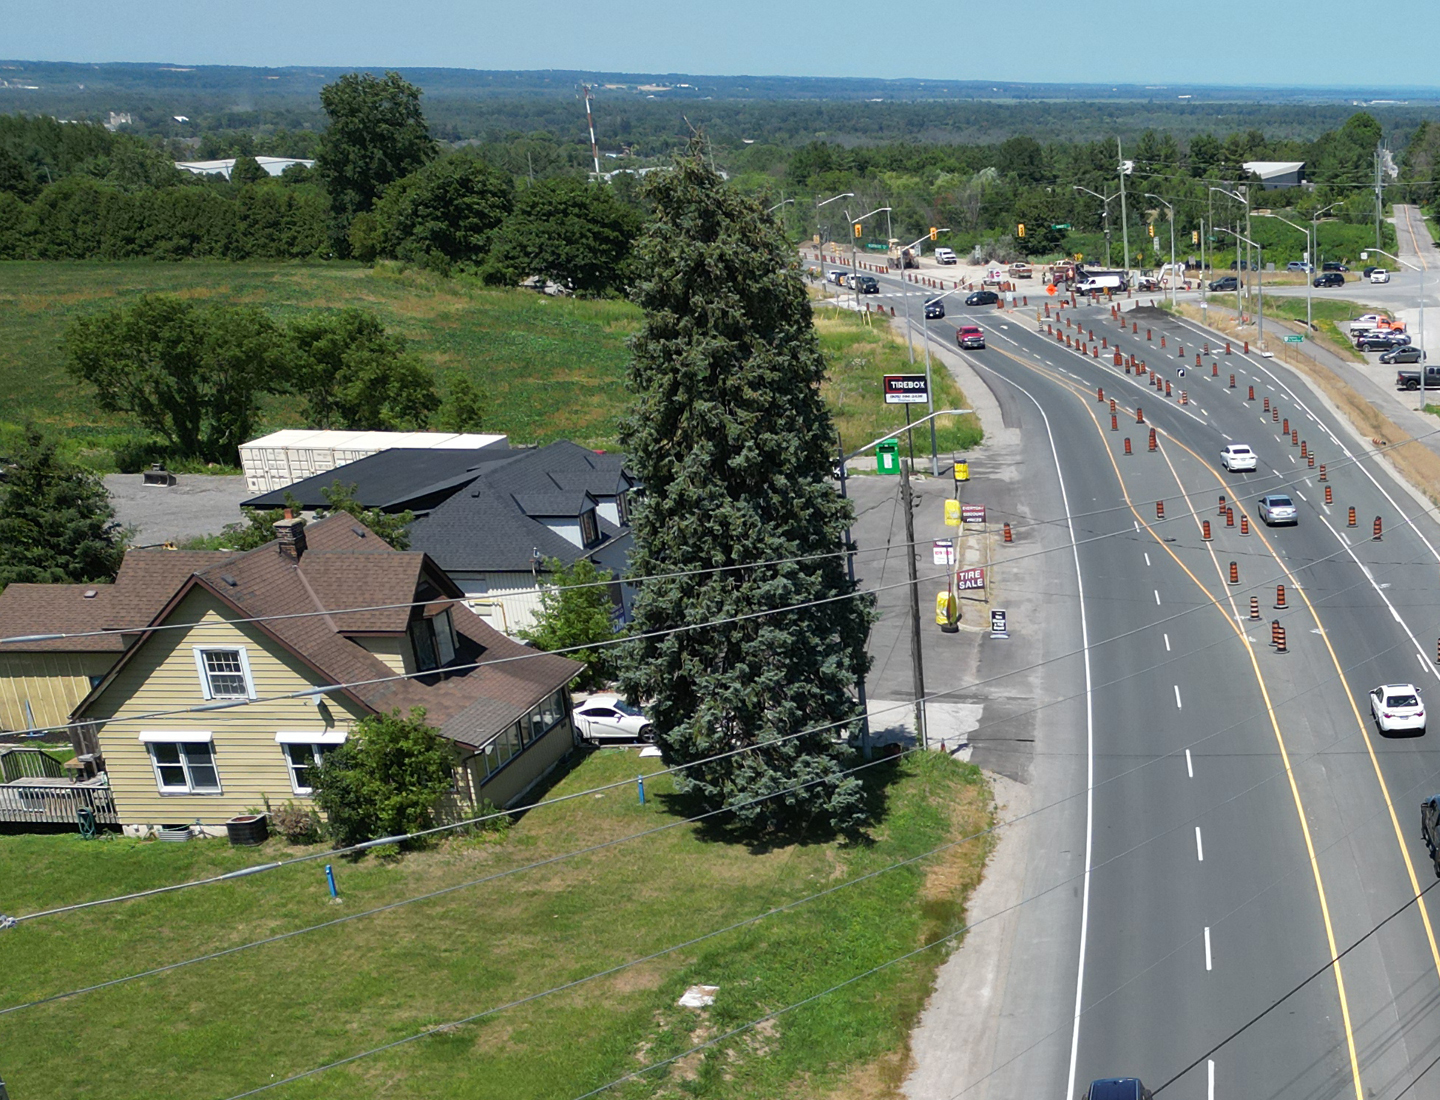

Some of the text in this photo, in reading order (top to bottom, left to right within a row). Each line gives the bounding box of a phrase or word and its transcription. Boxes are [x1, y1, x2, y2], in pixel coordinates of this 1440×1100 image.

[891, 381, 925, 389] TIREBOX
[959, 570, 981, 580] TIRE
[959, 579, 984, 589] SALE
